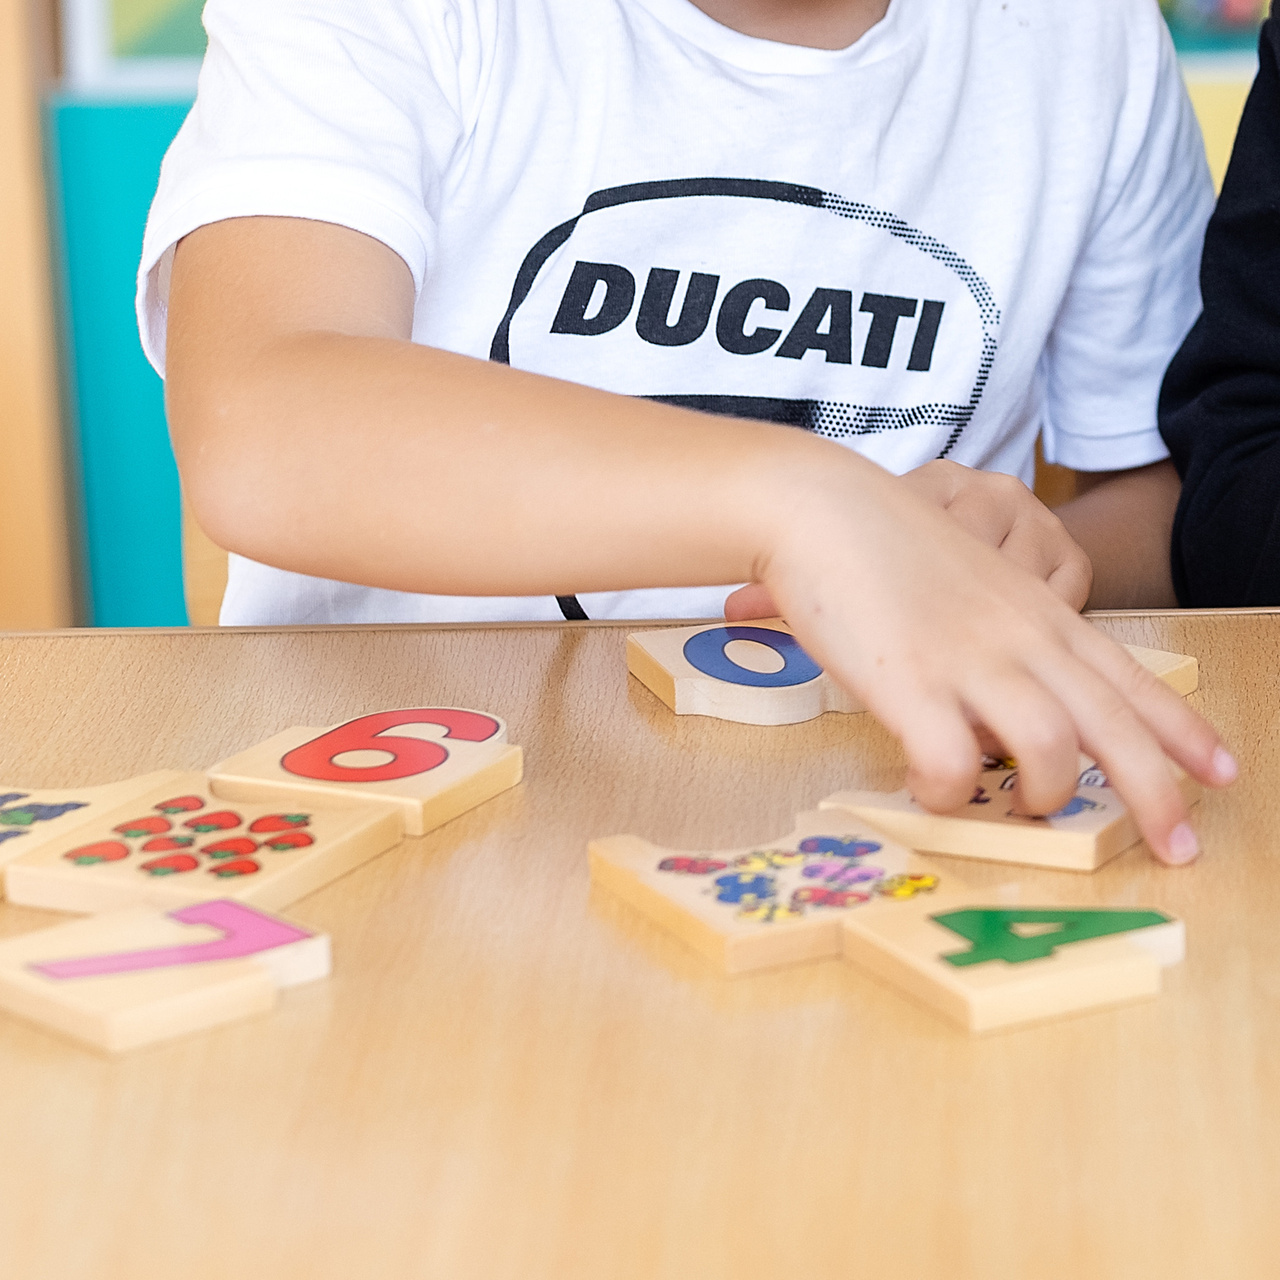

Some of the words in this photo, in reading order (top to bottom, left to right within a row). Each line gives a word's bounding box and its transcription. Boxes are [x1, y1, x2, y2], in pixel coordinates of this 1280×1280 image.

[550, 261, 946, 372] DUCATI
[281, 707, 501, 783] 6
[28, 898, 314, 980] 7
[930, 907, 1172, 967] 4
